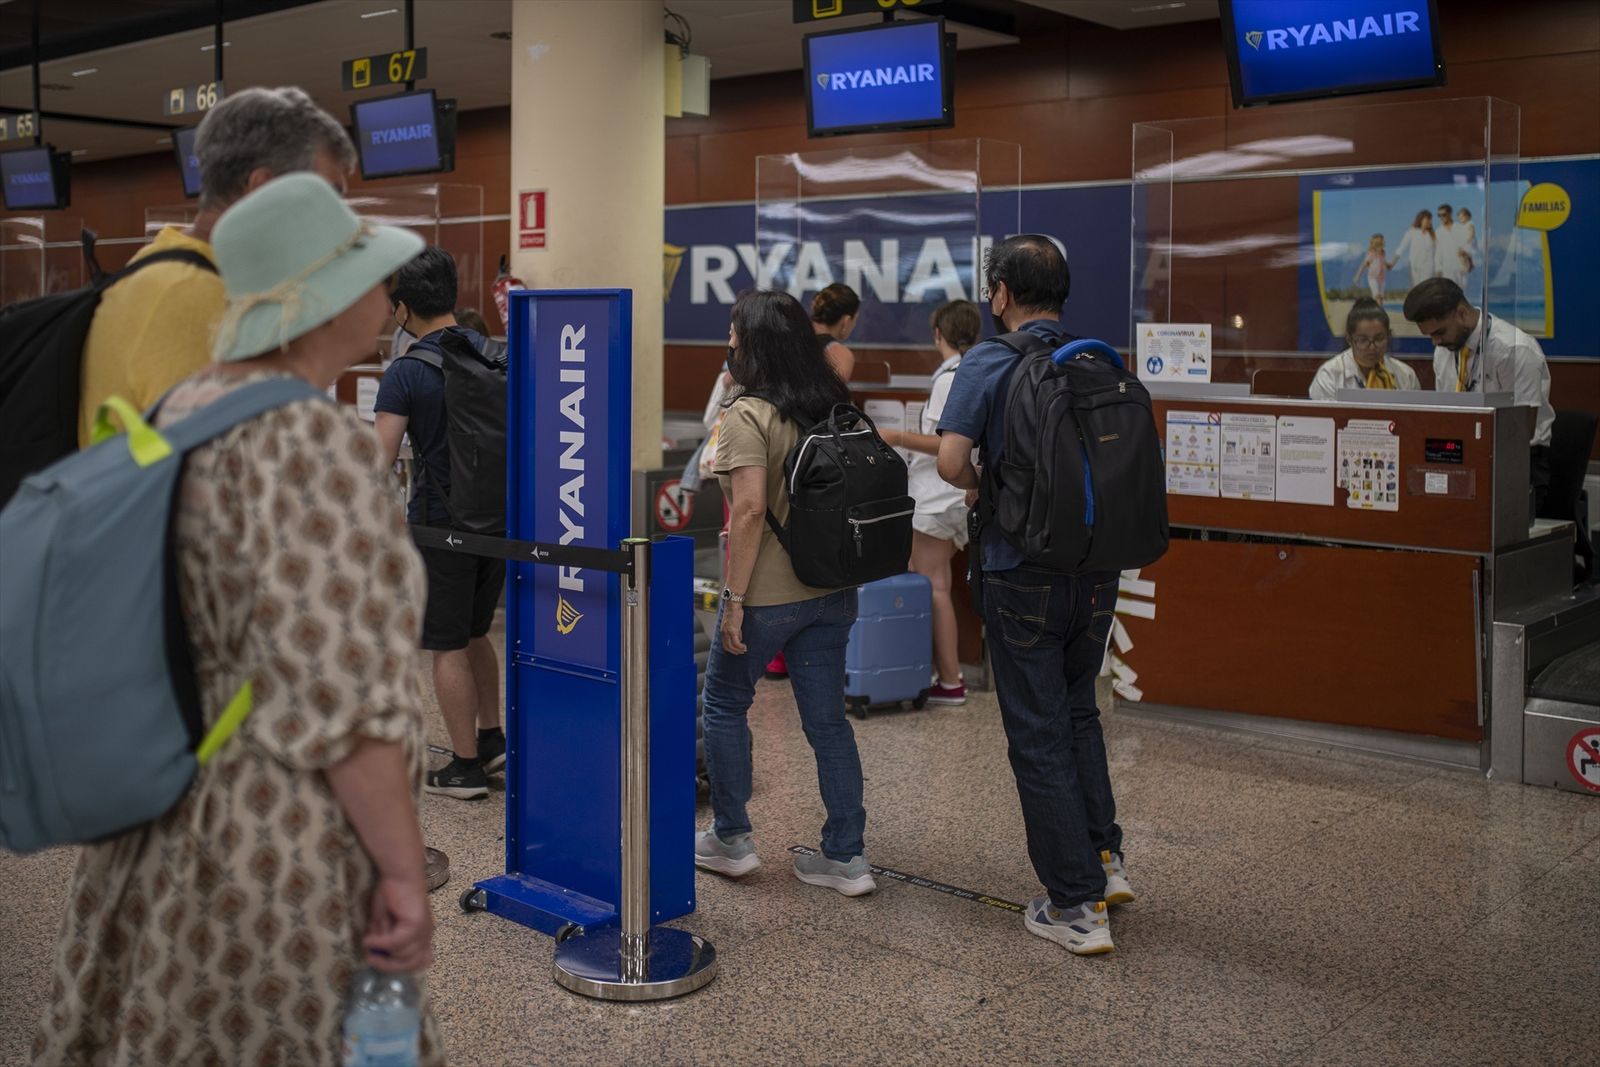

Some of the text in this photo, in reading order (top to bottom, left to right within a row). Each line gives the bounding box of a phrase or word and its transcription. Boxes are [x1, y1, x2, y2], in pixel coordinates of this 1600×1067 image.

[1266, 11, 1421, 50] RYANAIR
[388, 50, 416, 82] 67
[831, 63, 935, 91] RYANAIR
[196, 82, 217, 111] 66
[16, 113, 33, 138] 65
[371, 124, 432, 145] RYANAIR
[1523, 200, 1567, 213] FAMILIAS
[690, 233, 1068, 304] RYANAI
